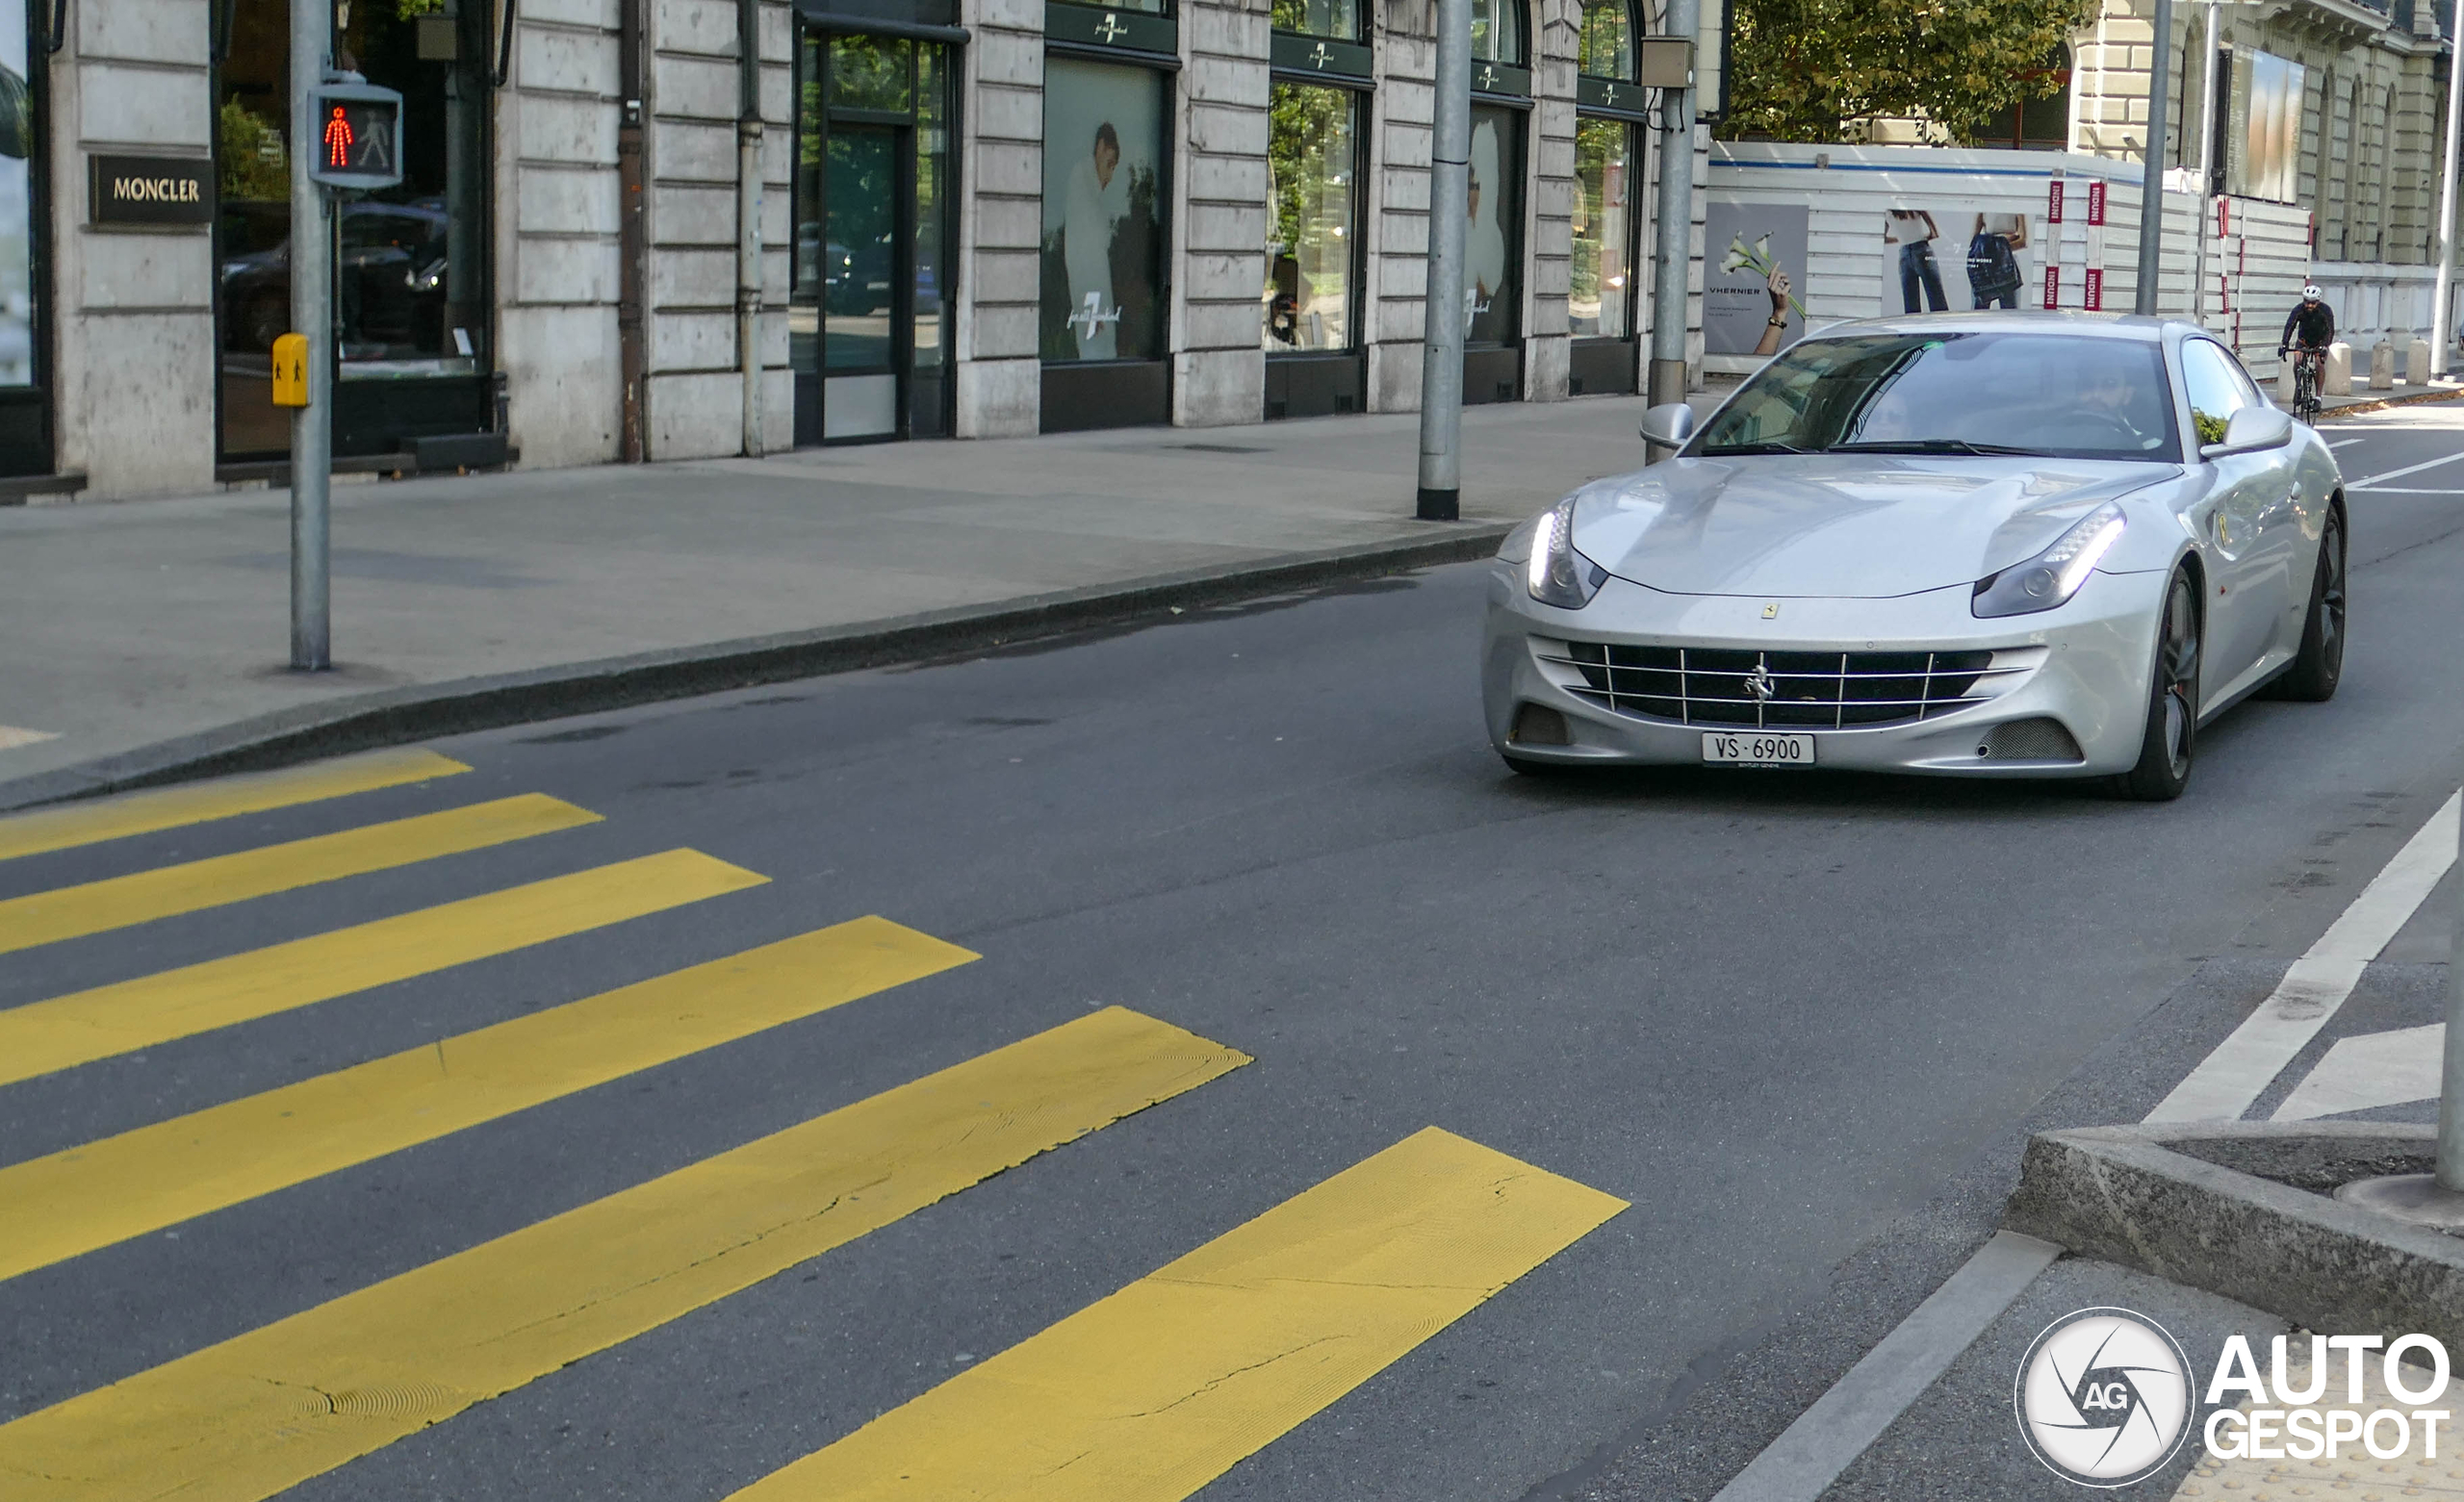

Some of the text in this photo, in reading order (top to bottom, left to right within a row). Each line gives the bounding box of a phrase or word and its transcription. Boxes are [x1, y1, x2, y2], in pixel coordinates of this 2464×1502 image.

[114, 177, 199, 202] MONCLER
[2051, 185, 2060, 219] INDUNI
[2091, 187, 2100, 221] INDUNI
[1709, 287, 1760, 295] VHERNIER
[2046, 270, 2056, 305] INDUNI
[2087, 273, 2096, 308] INDUNI
